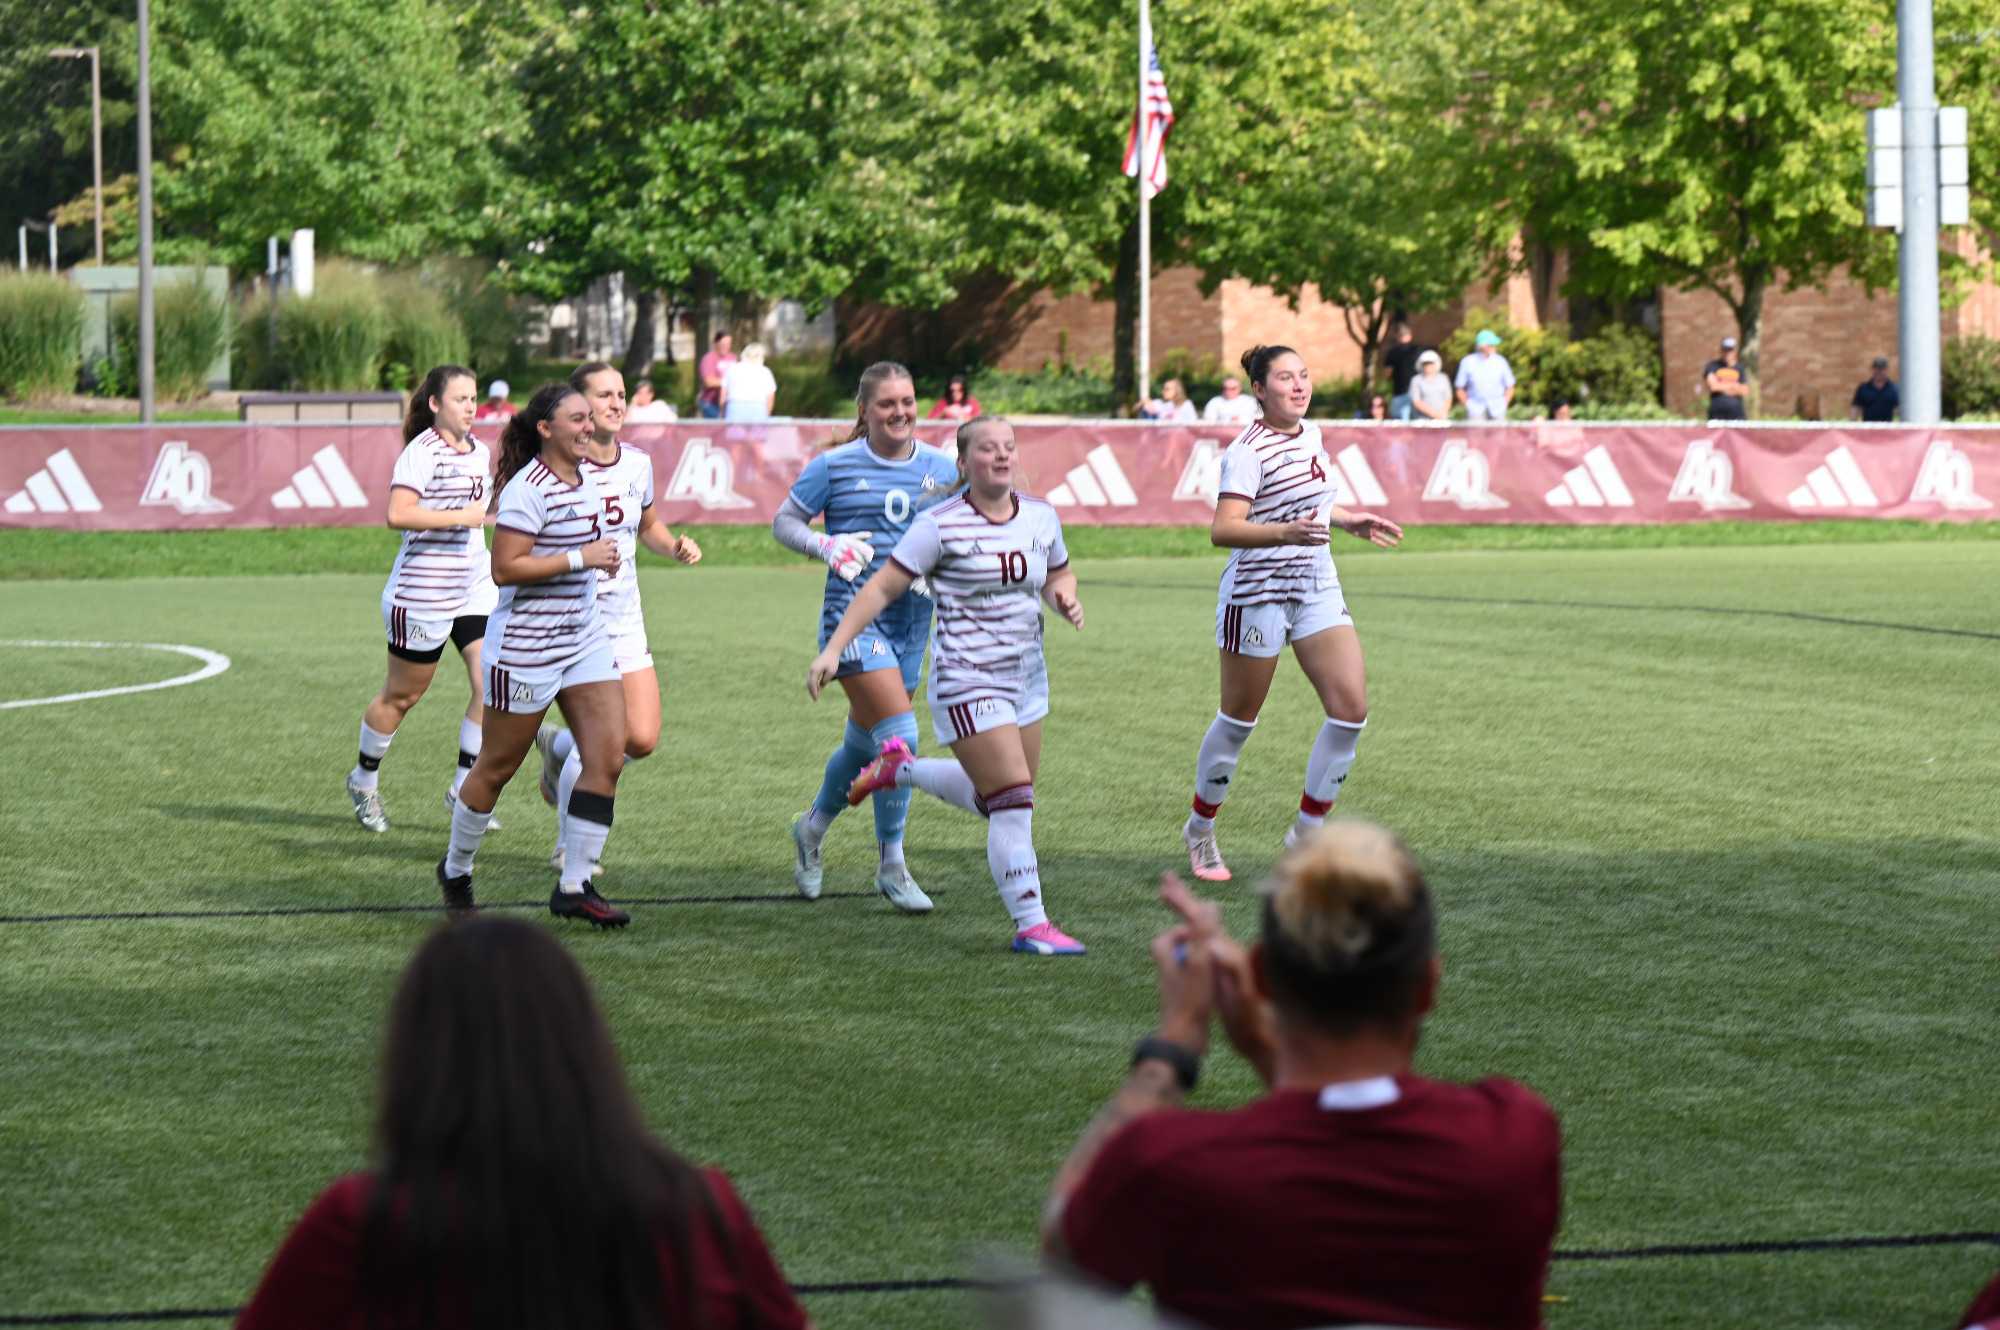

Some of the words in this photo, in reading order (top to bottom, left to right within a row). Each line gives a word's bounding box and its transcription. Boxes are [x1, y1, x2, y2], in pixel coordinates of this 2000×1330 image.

[1310, 455, 1326, 482] 4
[469, 476, 483, 501] 13
[604, 496, 624, 525] 5
[588, 514, 601, 542] 3
[997, 550, 1027, 587] 10
